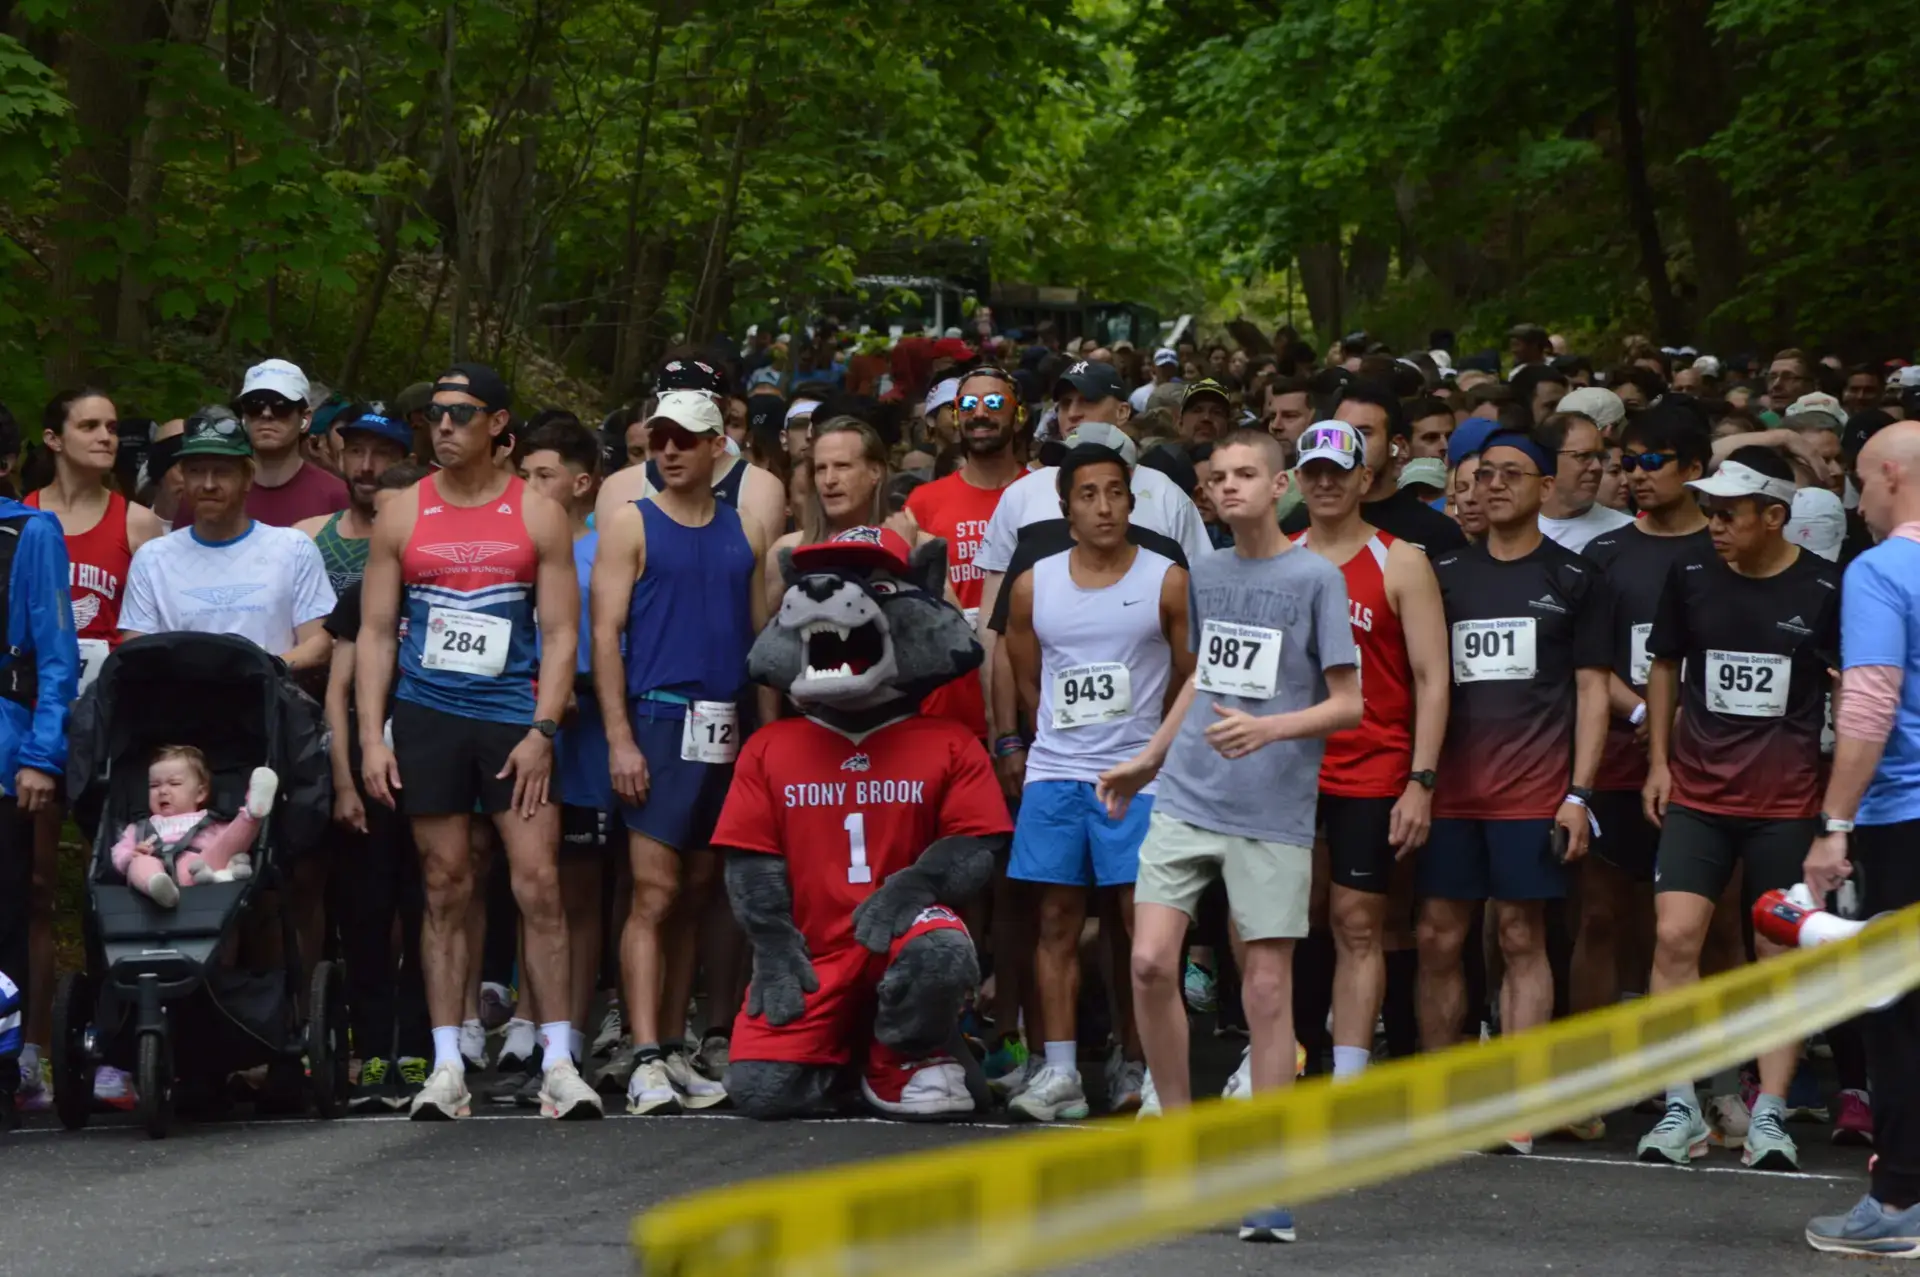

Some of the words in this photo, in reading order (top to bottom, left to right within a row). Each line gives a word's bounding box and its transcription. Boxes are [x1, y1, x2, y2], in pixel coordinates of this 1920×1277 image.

[78, 563, 117, 600] HILLS
[471, 565, 516, 578] RUNNERS
[1238, 627, 1272, 640] Services
[1496, 620, 1527, 629] Services
[442, 630, 487, 656] 284
[1207, 635, 1262, 671] 987
[1464, 630, 1515, 659] 901
[1751, 655, 1782, 665] Services
[1064, 673, 1115, 706] 943
[1719, 663, 1774, 693] 952
[705, 722, 733, 745] 12
[784, 782, 847, 808] STONY
[855, 779, 925, 805] BROOK
[843, 812, 872, 884] 1
